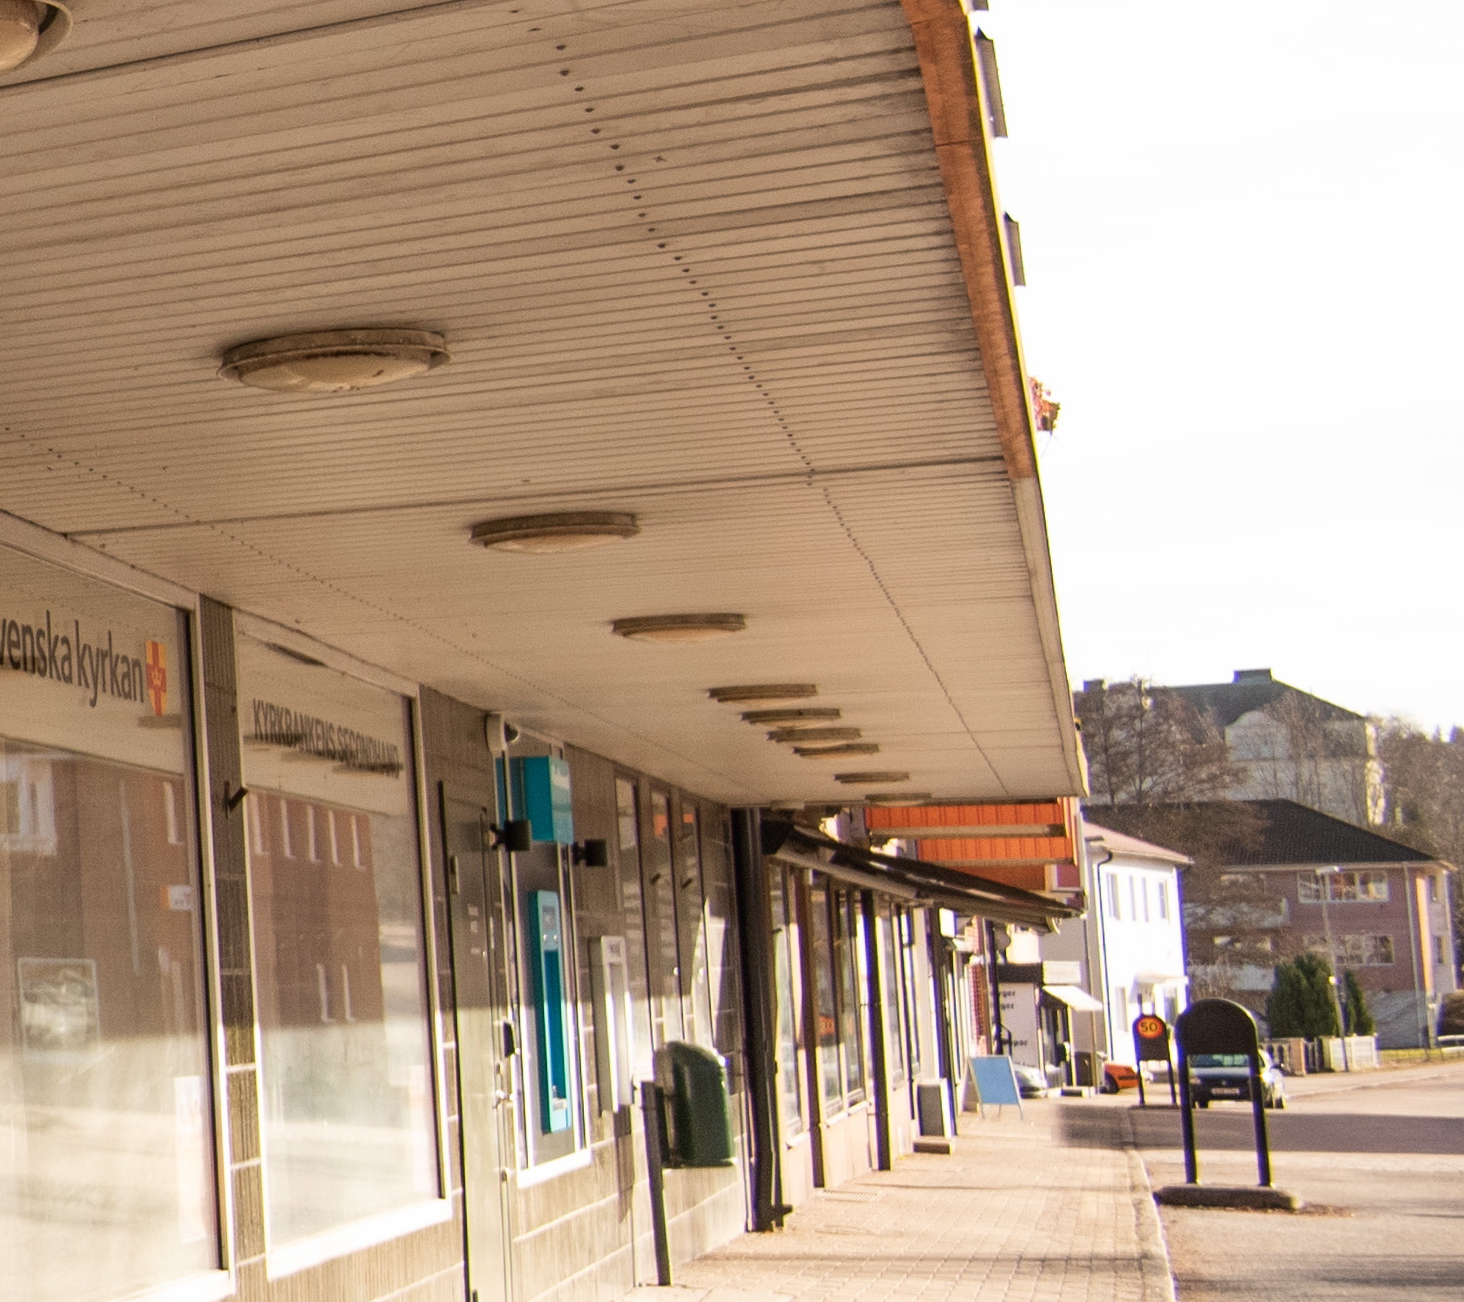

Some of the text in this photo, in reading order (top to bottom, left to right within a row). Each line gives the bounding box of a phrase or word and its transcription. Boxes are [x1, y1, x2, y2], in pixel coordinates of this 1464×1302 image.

[74, 618, 145, 708] kyrkan
[252, 697, 401, 781] KYRKBANKENS SECONDHAND
[1140, 1021, 1158, 1033] 50
